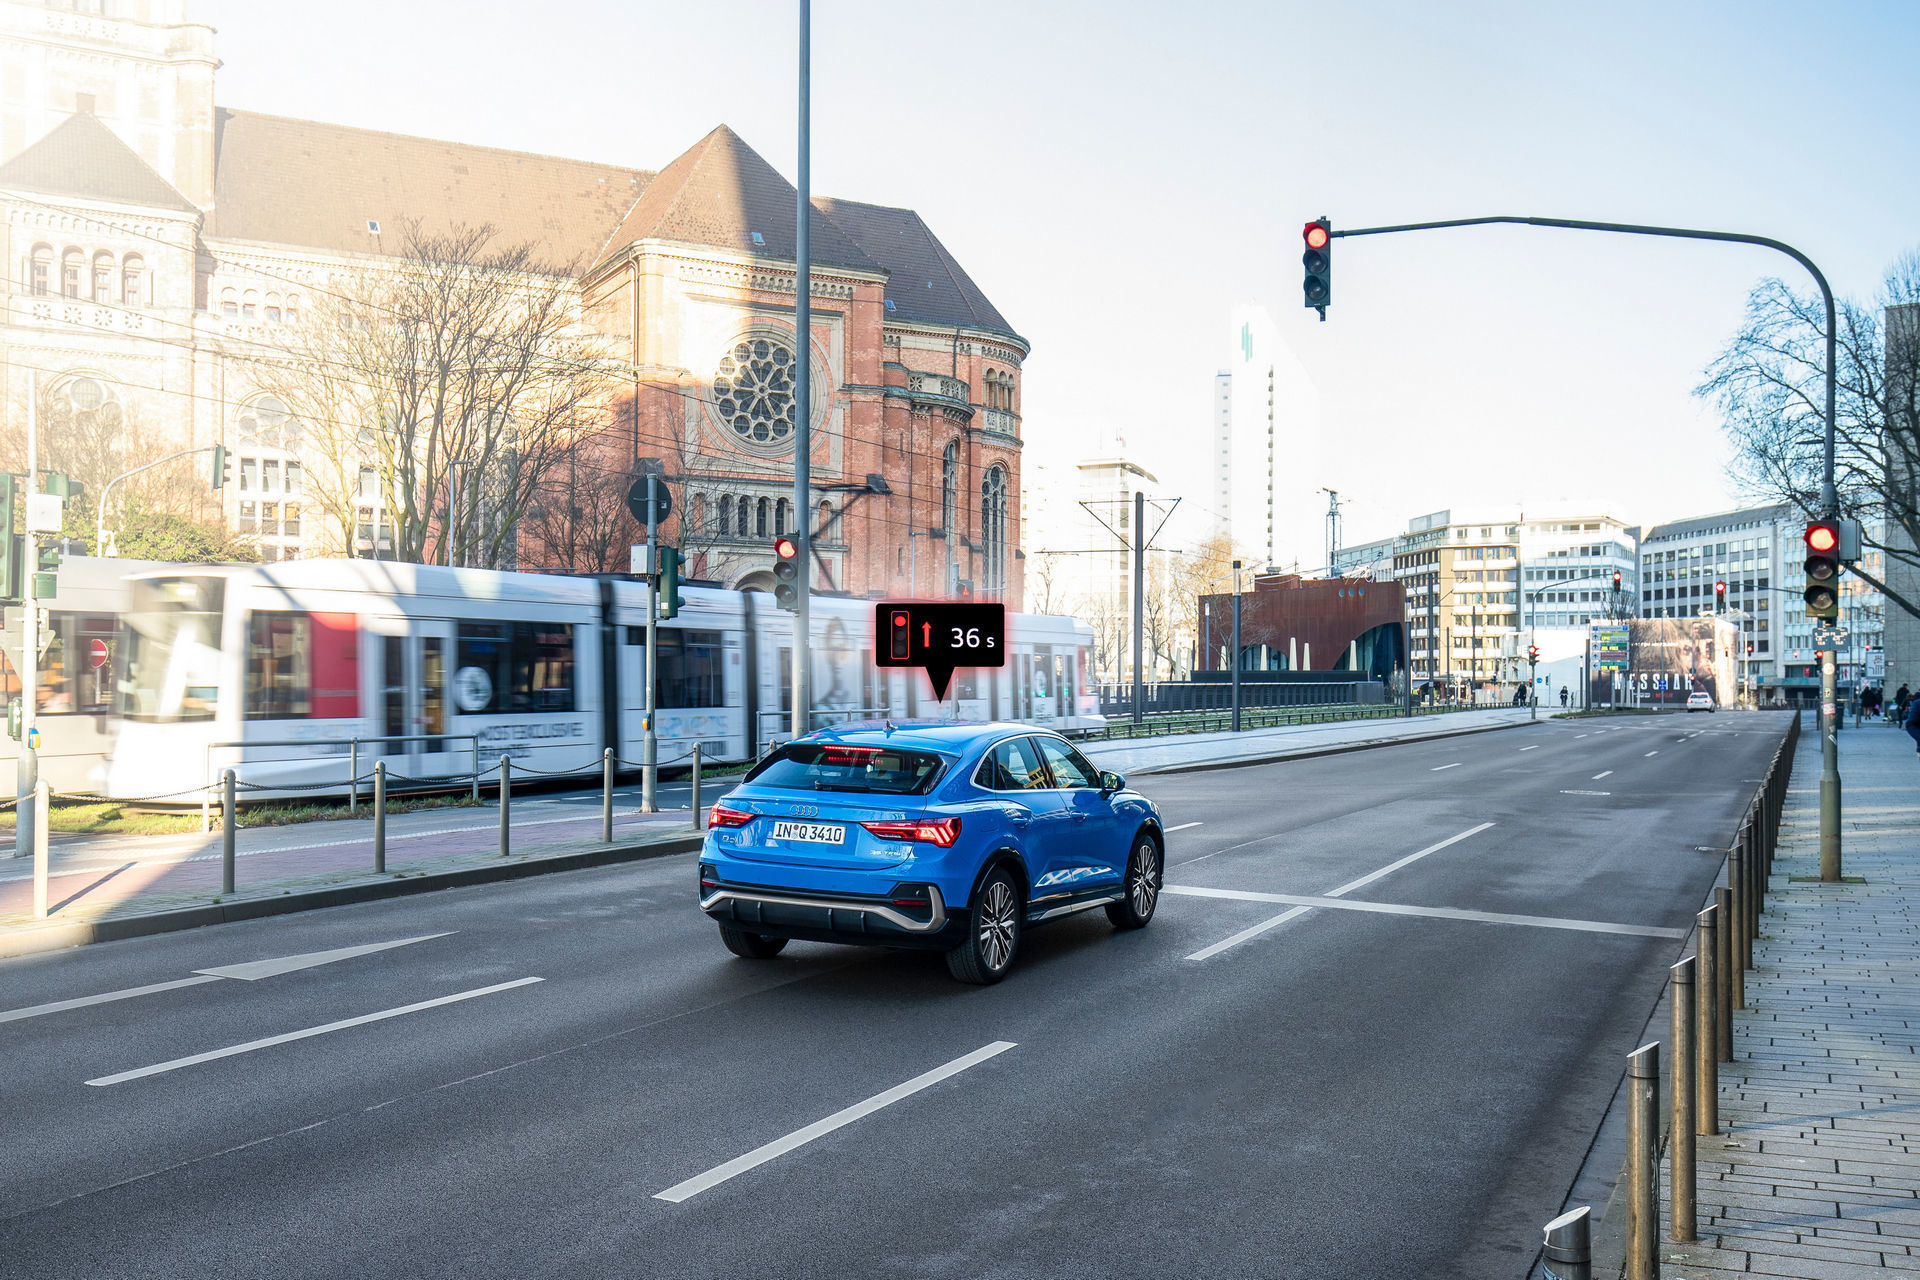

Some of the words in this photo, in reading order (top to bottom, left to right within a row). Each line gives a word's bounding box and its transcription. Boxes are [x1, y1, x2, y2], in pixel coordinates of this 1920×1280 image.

[775, 823, 793, 838] IN
[798, 825, 808, 840] Q
[809, 825, 842, 842] 3410
